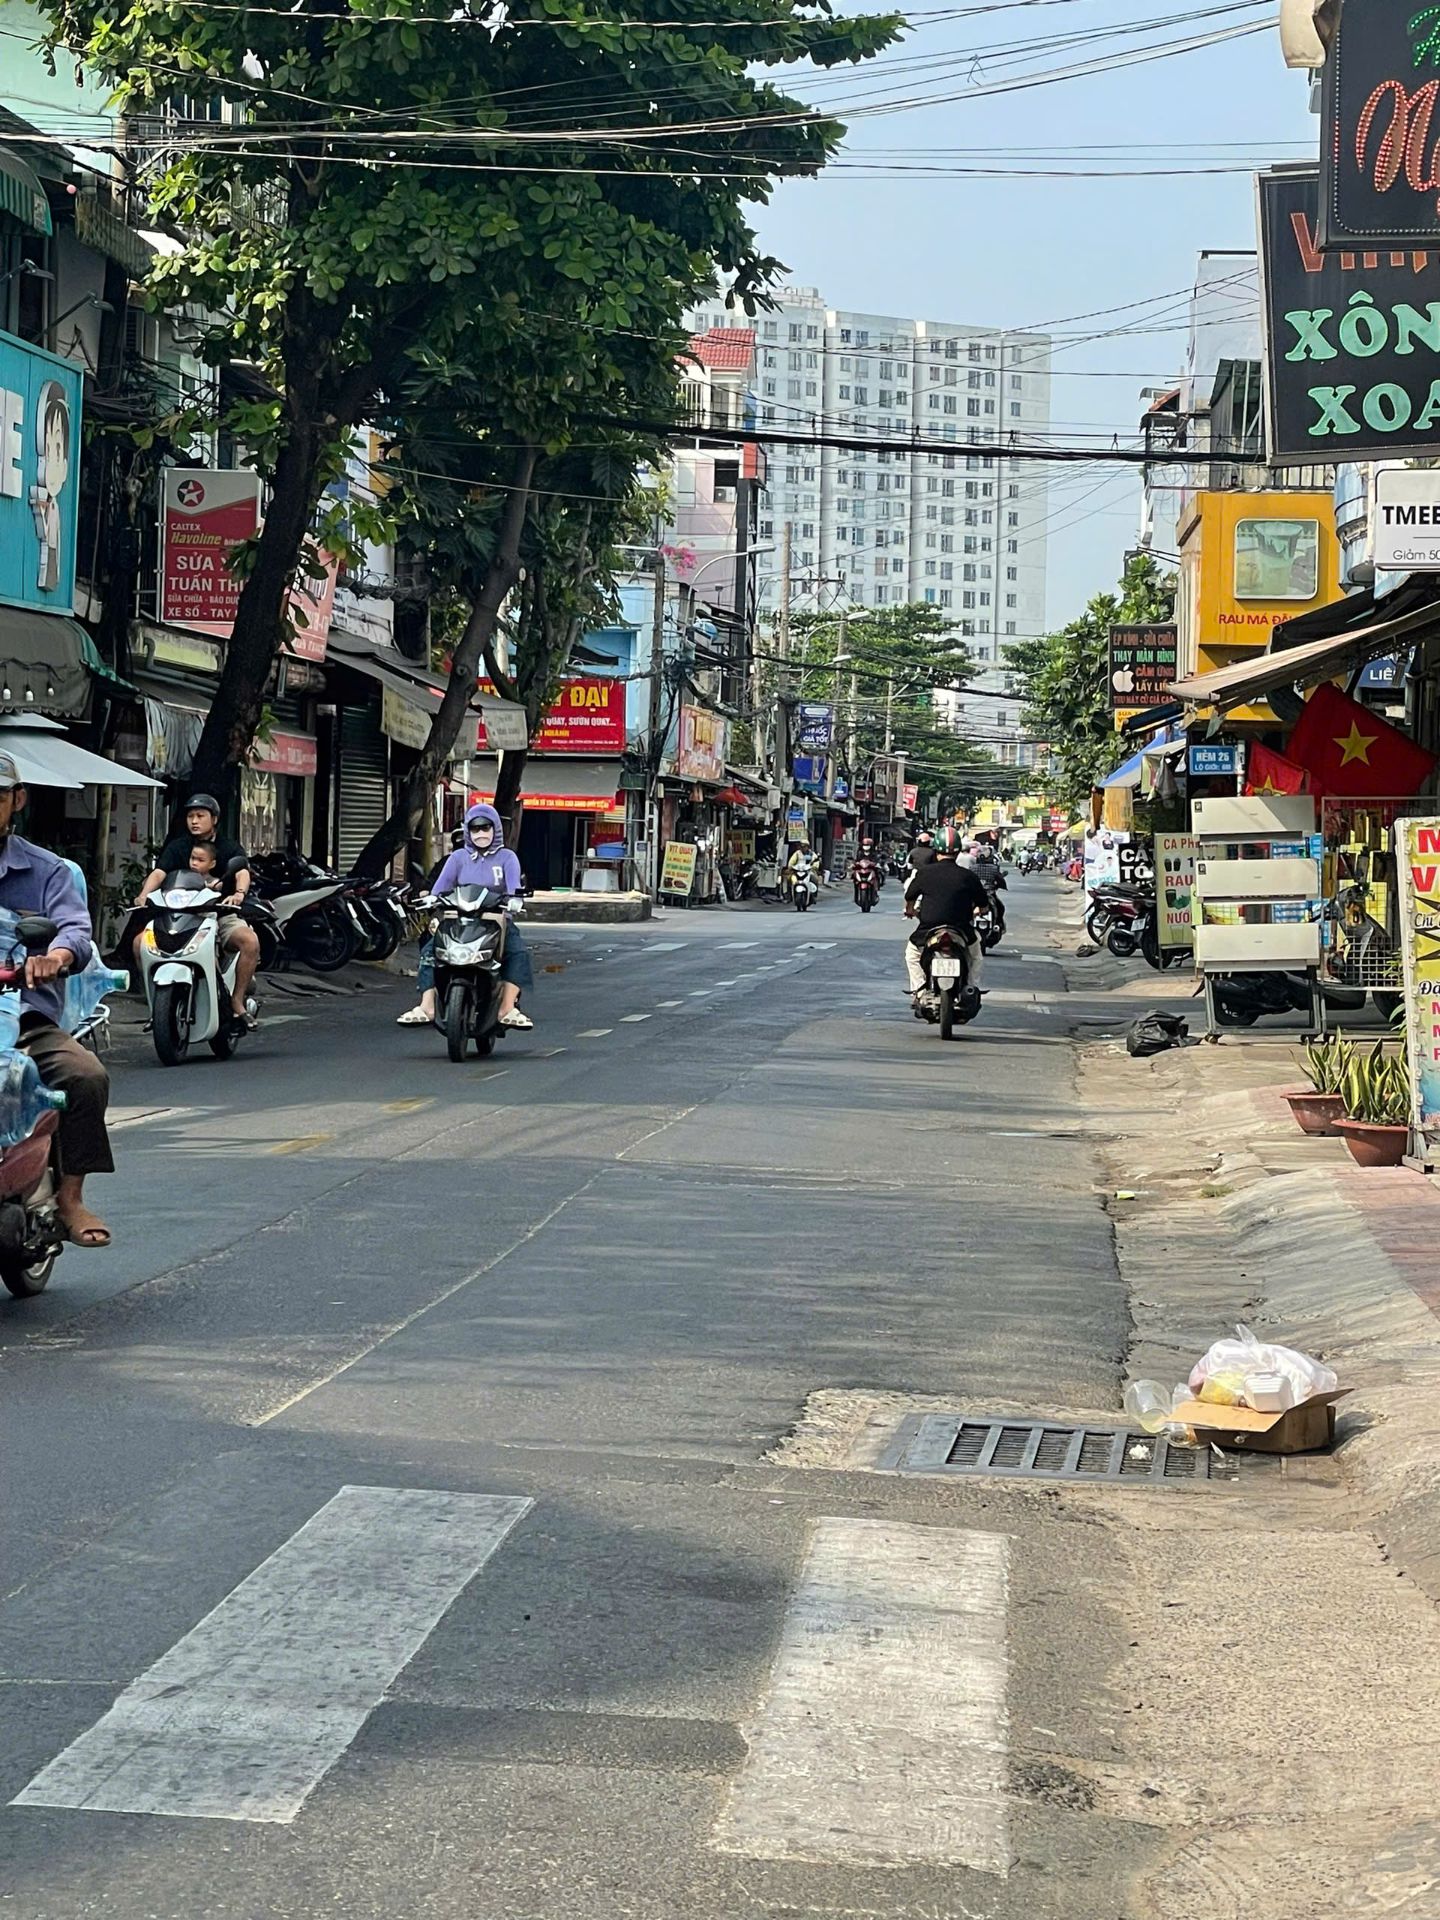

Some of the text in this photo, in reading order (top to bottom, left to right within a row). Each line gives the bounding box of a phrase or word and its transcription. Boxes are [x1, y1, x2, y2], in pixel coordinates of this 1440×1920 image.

[171, 523, 201, 531] CALTEX
[171, 532, 222, 545] Havoline
[1393, 549, 1426, 560] Giảm
[176, 552, 215, 571] SỬA
[169, 573, 212, 592] TUẤN
[168, 607, 181, 616] XE
[185, 605, 199, 617] SỐ
[210, 608, 231, 618] TAY
[1219, 614, 1244, 624] RAU
[1247, 612, 1268, 624] MÁ
[1113, 650, 1133, 662] THAY
[1136, 648, 1153, 662] MÀN
[1369, 667, 1396, 680] LIÊ
[1136, 680, 1153, 692] LẤY
[570, 686, 609, 712] ĐẠI
[1163, 838, 1177, 850] CA
[492, 866, 503, 885] P
[1166, 875, 1193, 886] RAU
